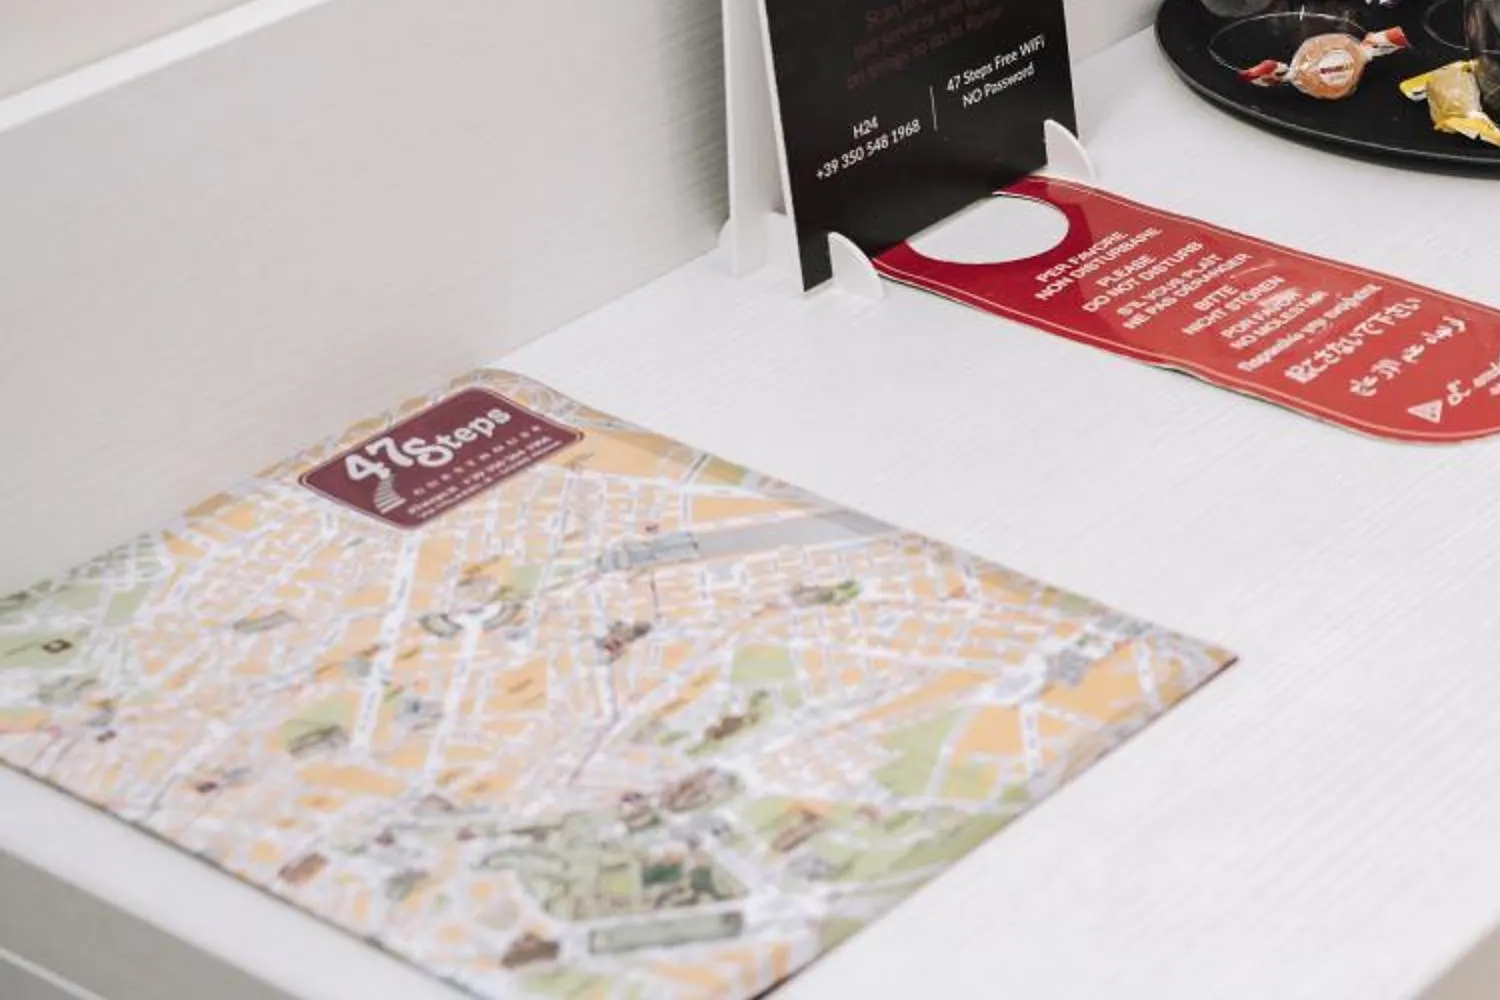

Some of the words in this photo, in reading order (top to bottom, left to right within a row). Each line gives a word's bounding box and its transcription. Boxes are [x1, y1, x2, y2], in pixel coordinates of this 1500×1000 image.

[946, 74, 961, 91] 47
[963, 63, 993, 85] Steps
[994, 51, 1019, 70] Free
[962, 88, 983, 108] NO
[984, 61, 1035, 97] Password
[852, 115, 879, 139] H24
[816, 158, 839, 180] +39
[841, 146, 865, 169] 350
[866, 132, 889, 157] 548
[891, 119, 921, 143] 1968
[1034, 276, 1075, 300] NON
[1069, 227, 1163, 279] DISTURBARE
[1035, 262, 1072, 283] PER
[1068, 231, 1129, 265] FAVORE
[1081, 295, 1111, 313] DO
[1106, 277, 1142, 298] NOT
[1137, 241, 1204, 281] DISTURB
[1096, 254, 1157, 287] PLEASE
[1192, 284, 1240, 311] BITTE
[1181, 307, 1228, 335] NICHT
